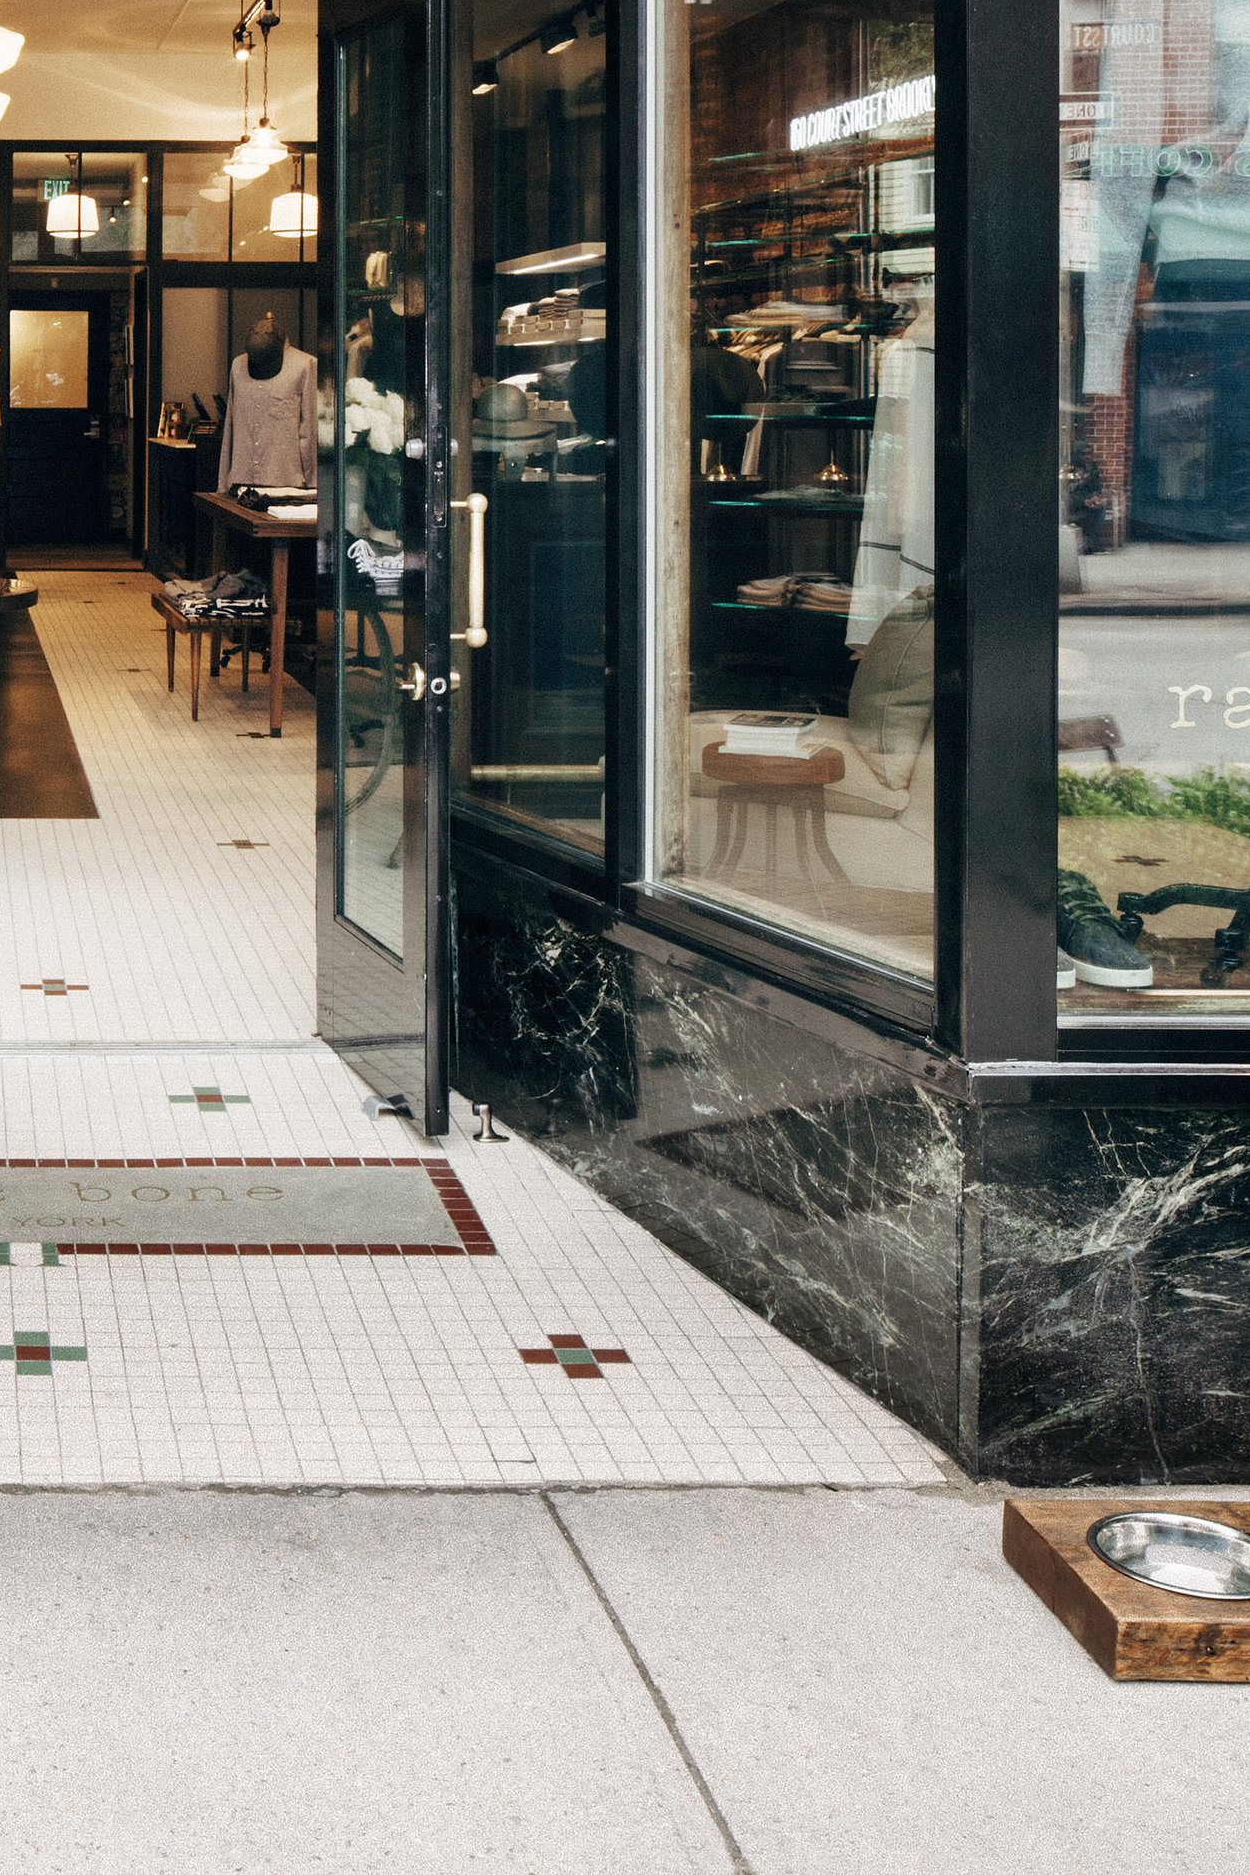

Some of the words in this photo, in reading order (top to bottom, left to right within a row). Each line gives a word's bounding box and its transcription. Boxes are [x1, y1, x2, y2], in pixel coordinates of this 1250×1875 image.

[807, 106, 842, 147] COURT
[842, 91, 887, 137] STREET
[44, 180, 71, 200] EXIT
[69, 1181, 284, 1203] bone
[12, 1216, 125, 1228] YORK
